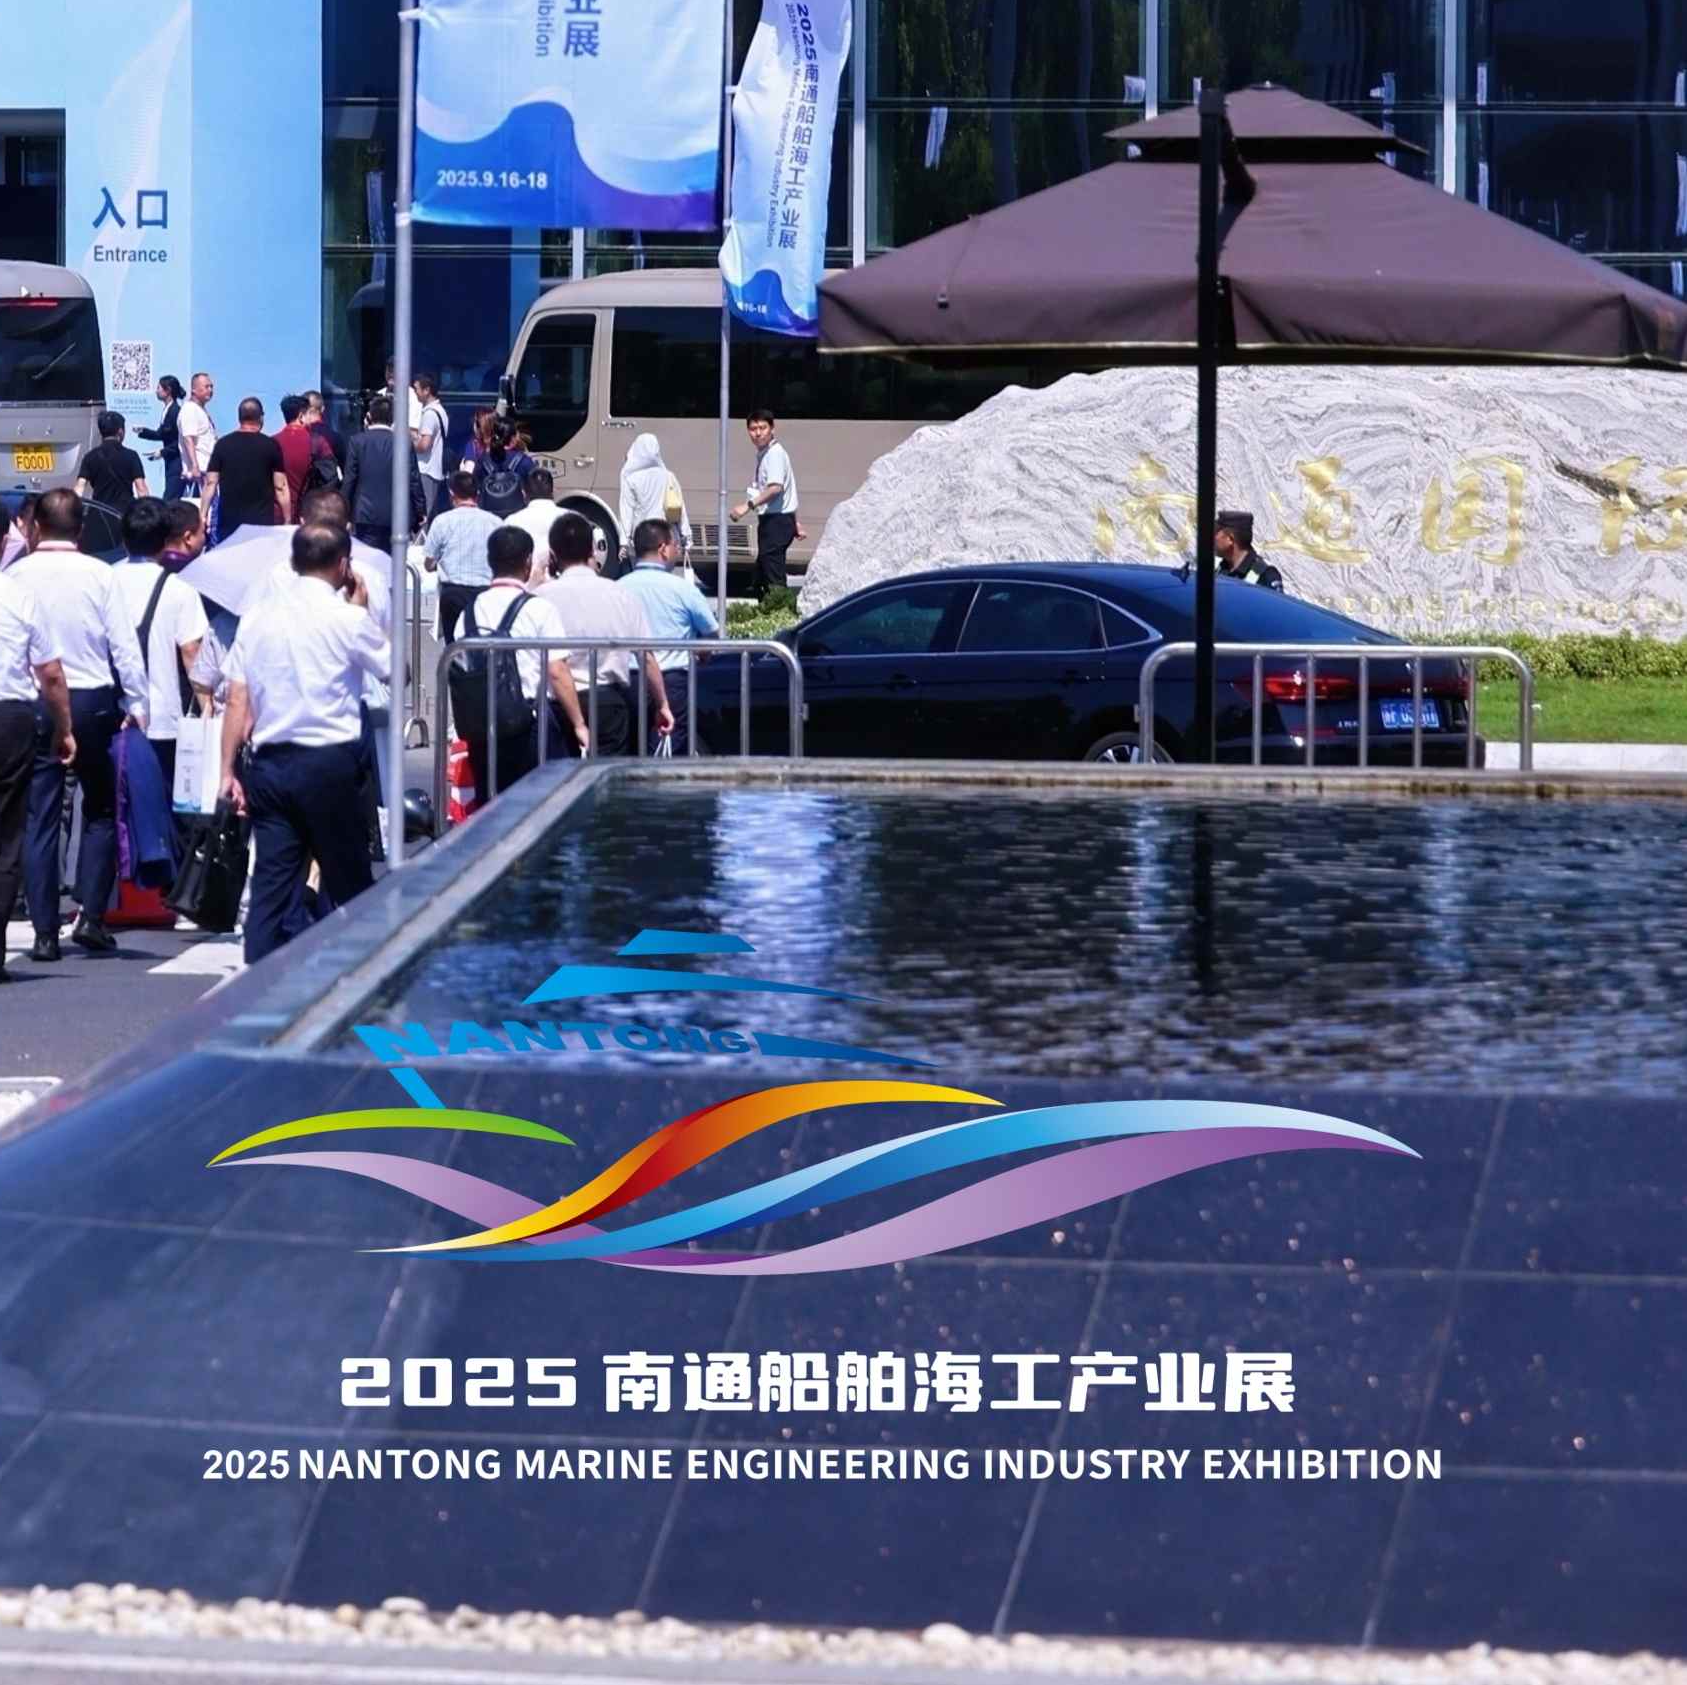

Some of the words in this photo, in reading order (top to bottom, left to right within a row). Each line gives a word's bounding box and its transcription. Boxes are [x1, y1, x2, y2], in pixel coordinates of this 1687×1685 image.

[778, 2, 819, 251] 2025南通船舶海工产业展
[436, 169, 548, 190] 2025.9.16-18
[92, 186, 168, 229] 入口
[93, 244, 168, 262] Entrance
